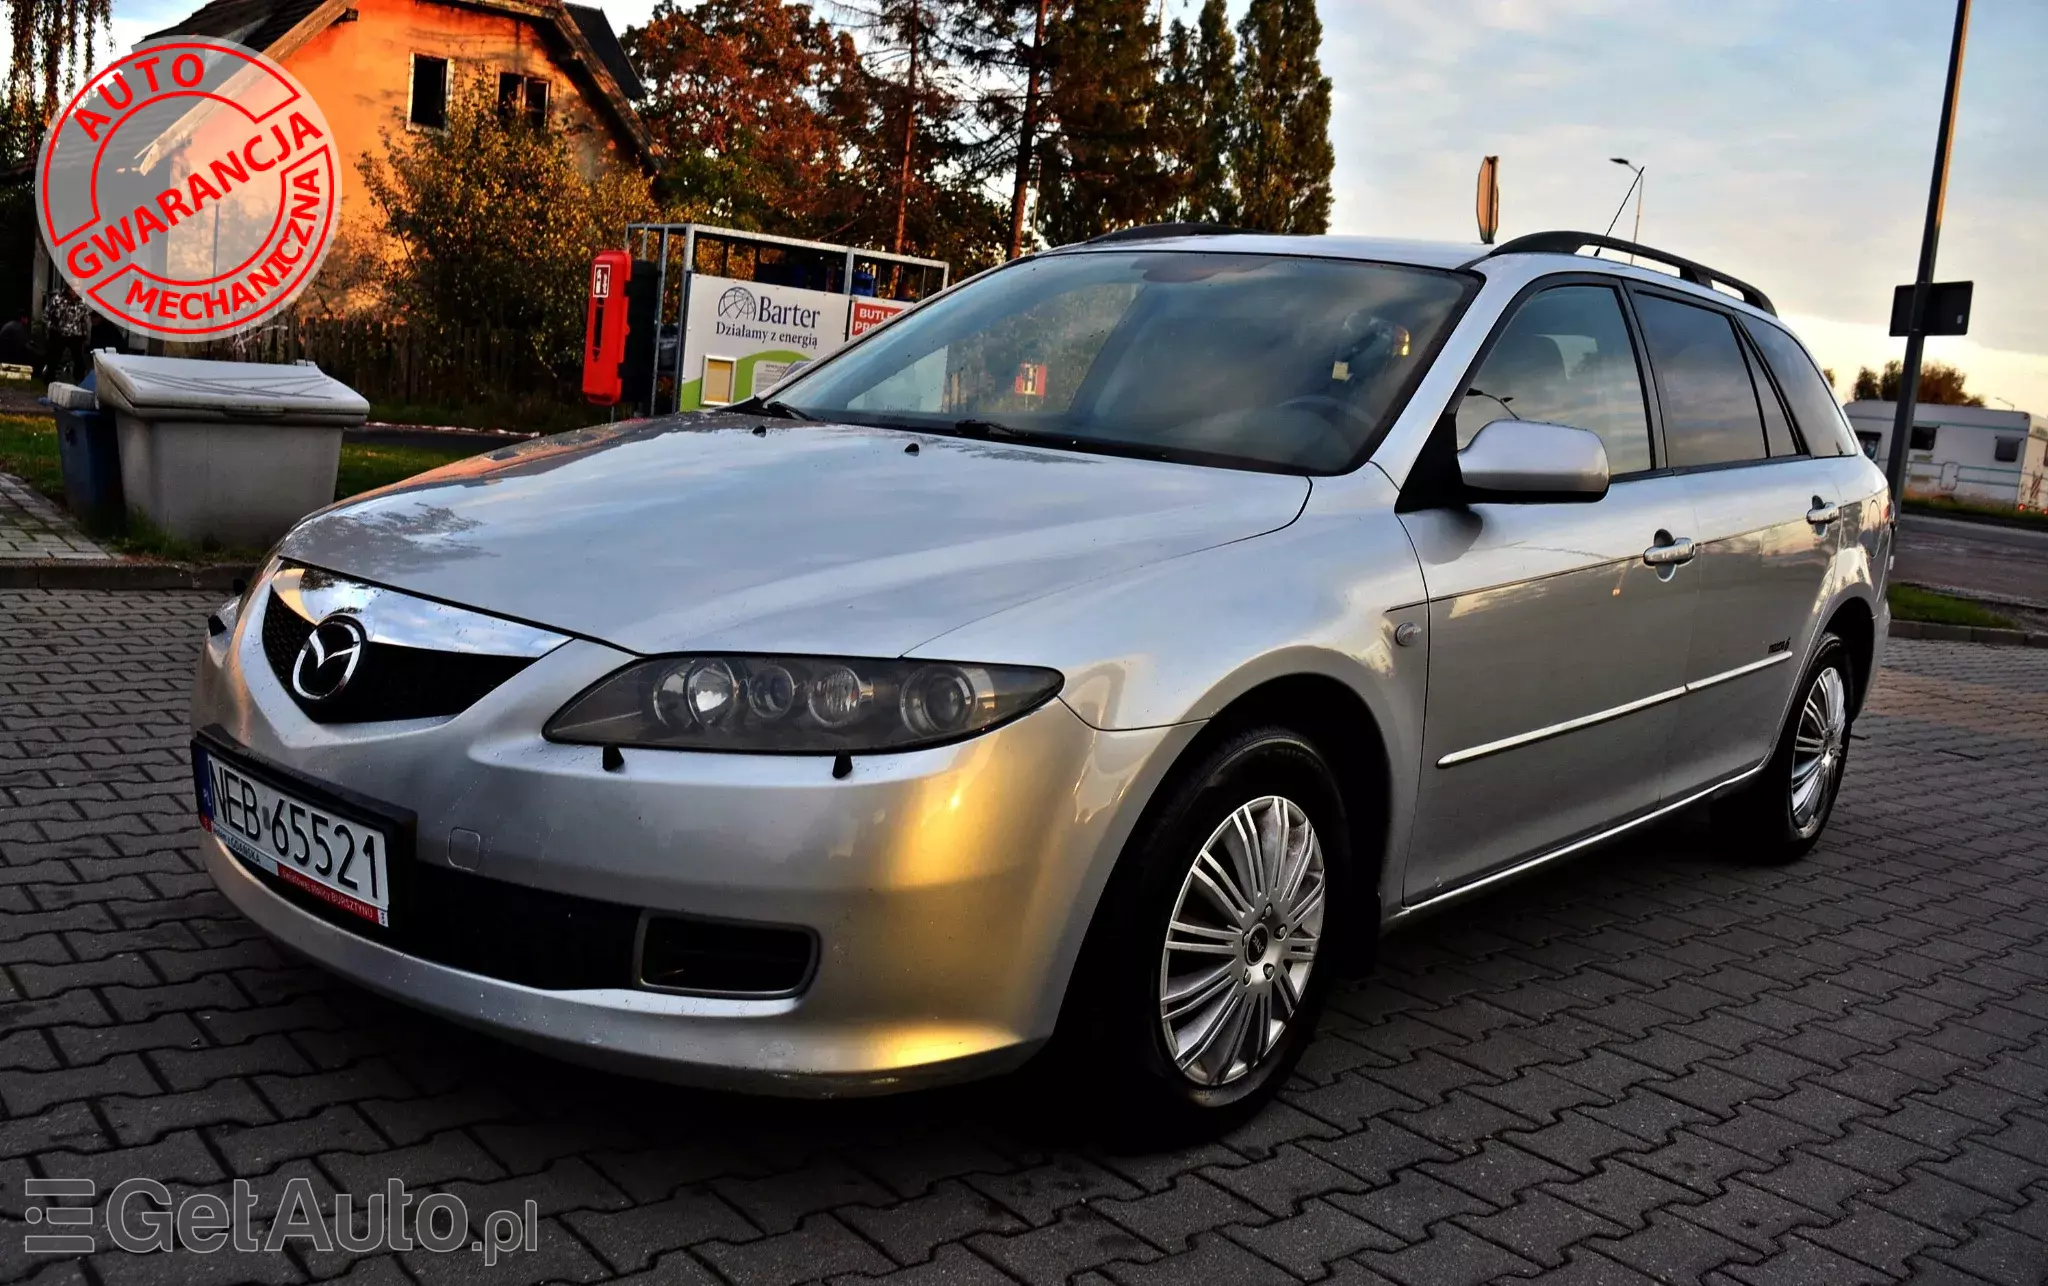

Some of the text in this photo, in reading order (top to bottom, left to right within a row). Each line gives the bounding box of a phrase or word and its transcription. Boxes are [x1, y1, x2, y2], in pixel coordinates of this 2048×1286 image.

[758, 296, 821, 329] Barter
[854, 321, 877, 332] PR
[715, 321, 818, 350] Działamy z energią
[208, 760, 378, 900] NEB 65521
